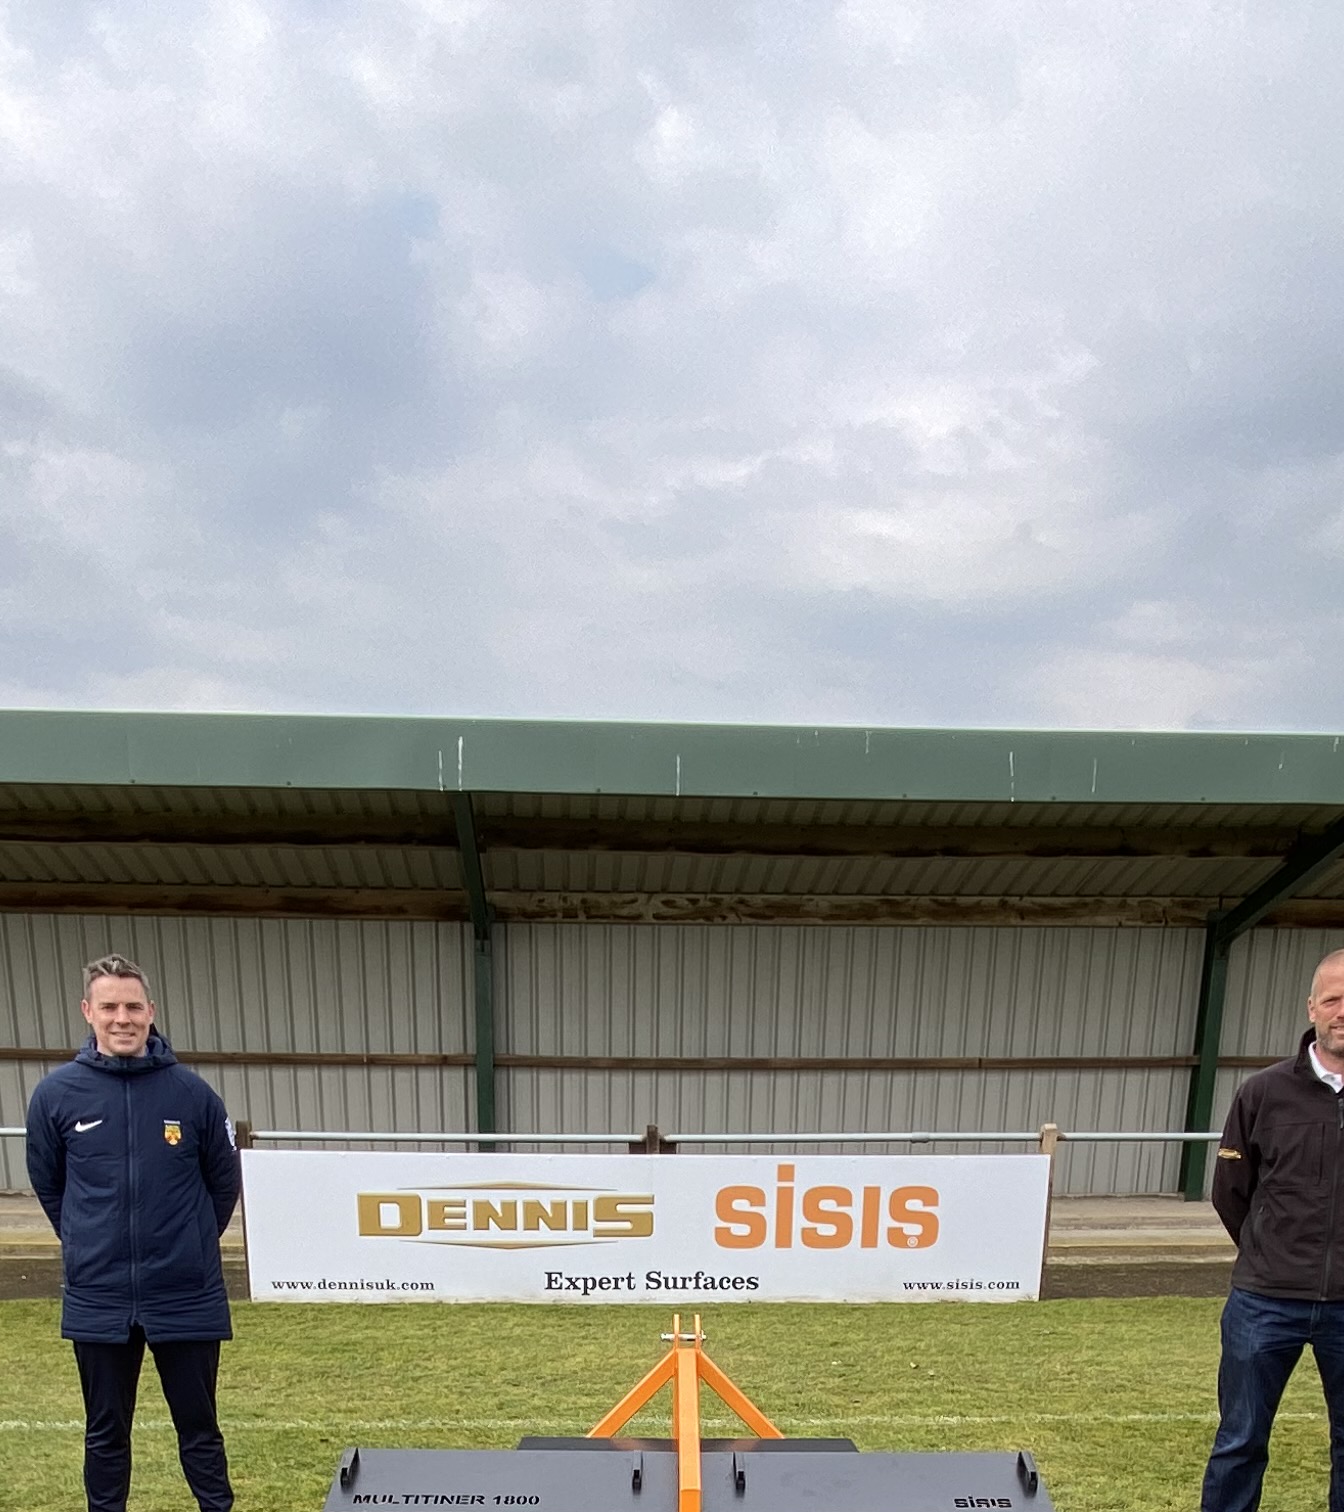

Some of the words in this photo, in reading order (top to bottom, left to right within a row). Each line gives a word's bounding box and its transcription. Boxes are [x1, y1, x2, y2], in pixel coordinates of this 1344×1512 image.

[357, 1192, 655, 1238] DENNIS
[270, 1277, 436, 1292] www.dennisuk.com
[544, 1271, 637, 1297] Expert
[644, 1270, 761, 1292] Surfaces
[902, 1278, 1021, 1291] www.sisis.com
[352, 1494, 486, 1505] MULTITINER
[492, 1494, 541, 1506] 1800
